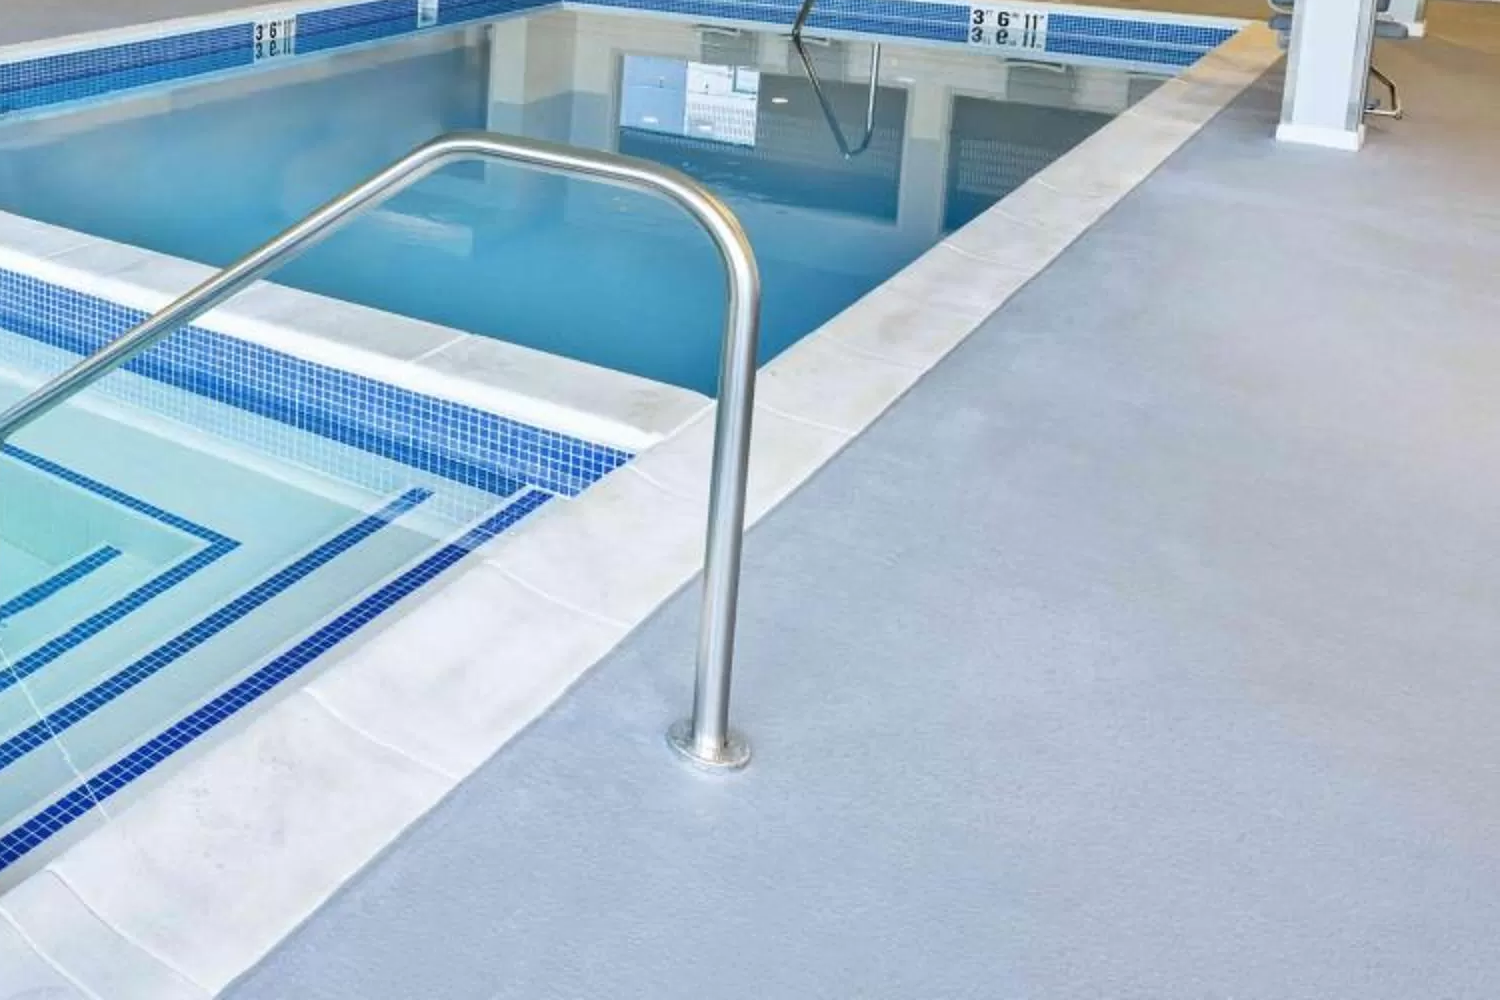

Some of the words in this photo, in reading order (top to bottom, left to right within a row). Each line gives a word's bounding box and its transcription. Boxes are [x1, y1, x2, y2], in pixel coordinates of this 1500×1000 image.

[972, 9, 985, 25] 3
[997, 11, 1010, 27] 6
[255, 24, 263, 41] 3
[269, 21, 277, 39] 6
